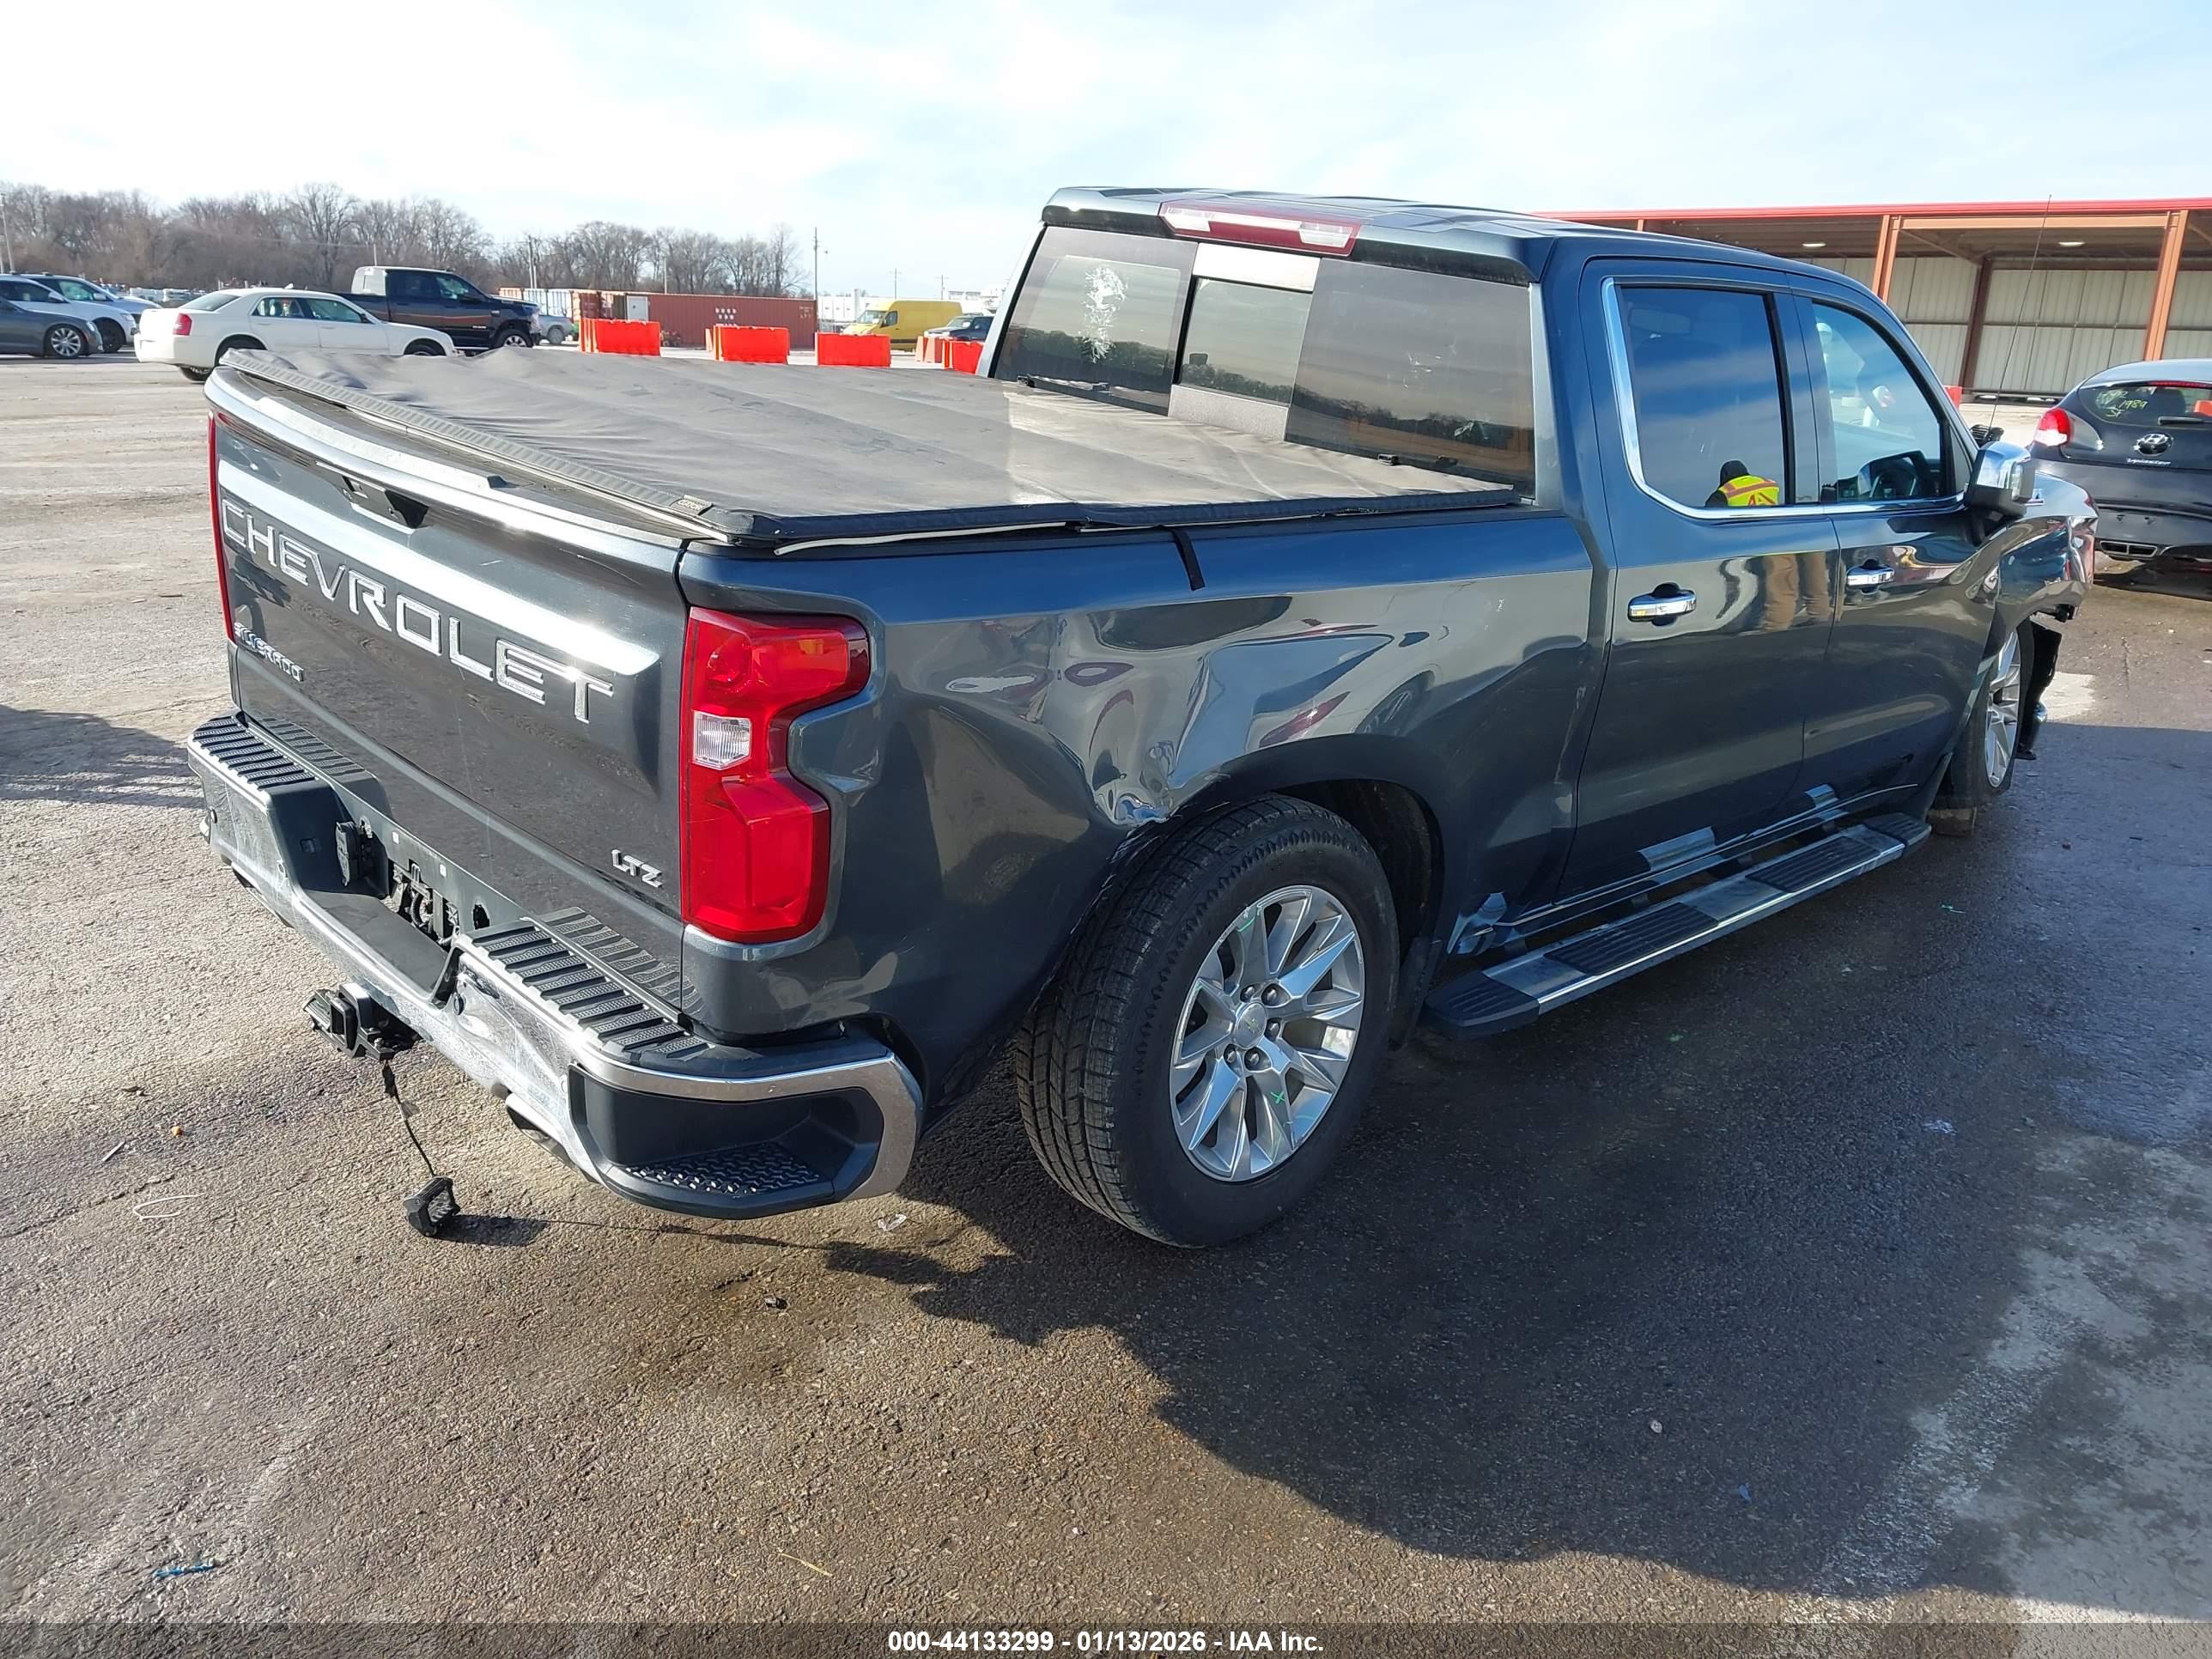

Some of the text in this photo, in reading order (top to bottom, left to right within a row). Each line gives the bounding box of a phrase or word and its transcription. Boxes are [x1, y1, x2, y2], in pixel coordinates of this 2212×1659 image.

[222, 497, 615, 724] CHEVROLET
[234, 622, 304, 682] SILVERADO
[611, 849, 663, 888] LTZ
